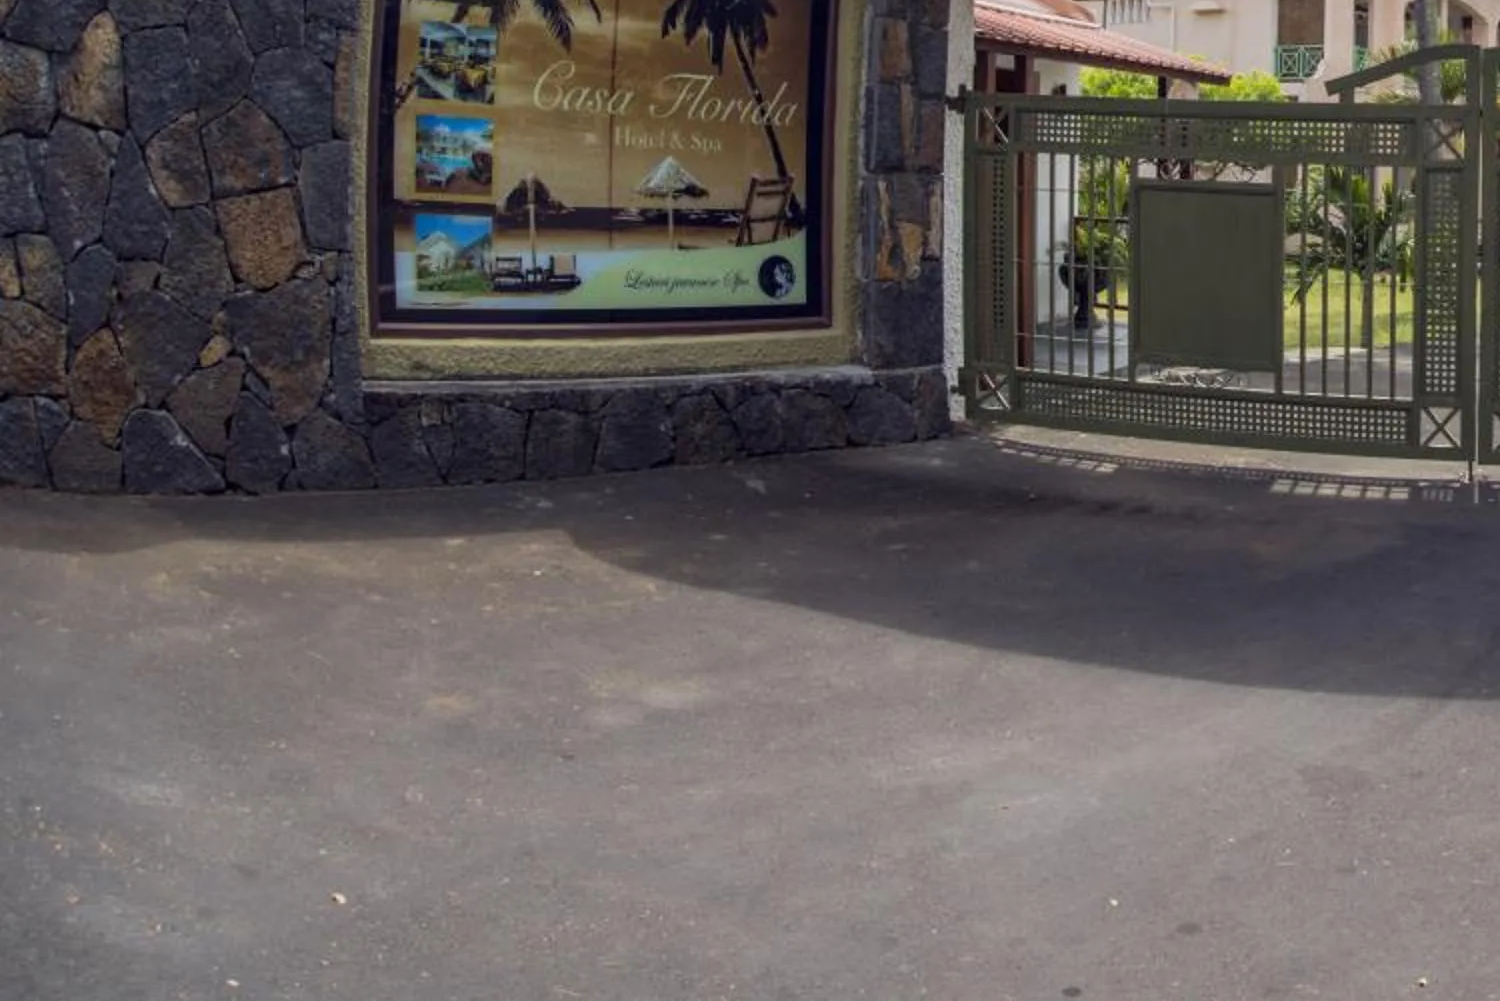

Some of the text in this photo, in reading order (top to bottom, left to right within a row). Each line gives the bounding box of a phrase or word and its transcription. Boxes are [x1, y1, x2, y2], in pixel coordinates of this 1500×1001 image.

[533, 60, 798, 127] Casa Florida
[615, 126, 722, 154] Hotel & Spa
